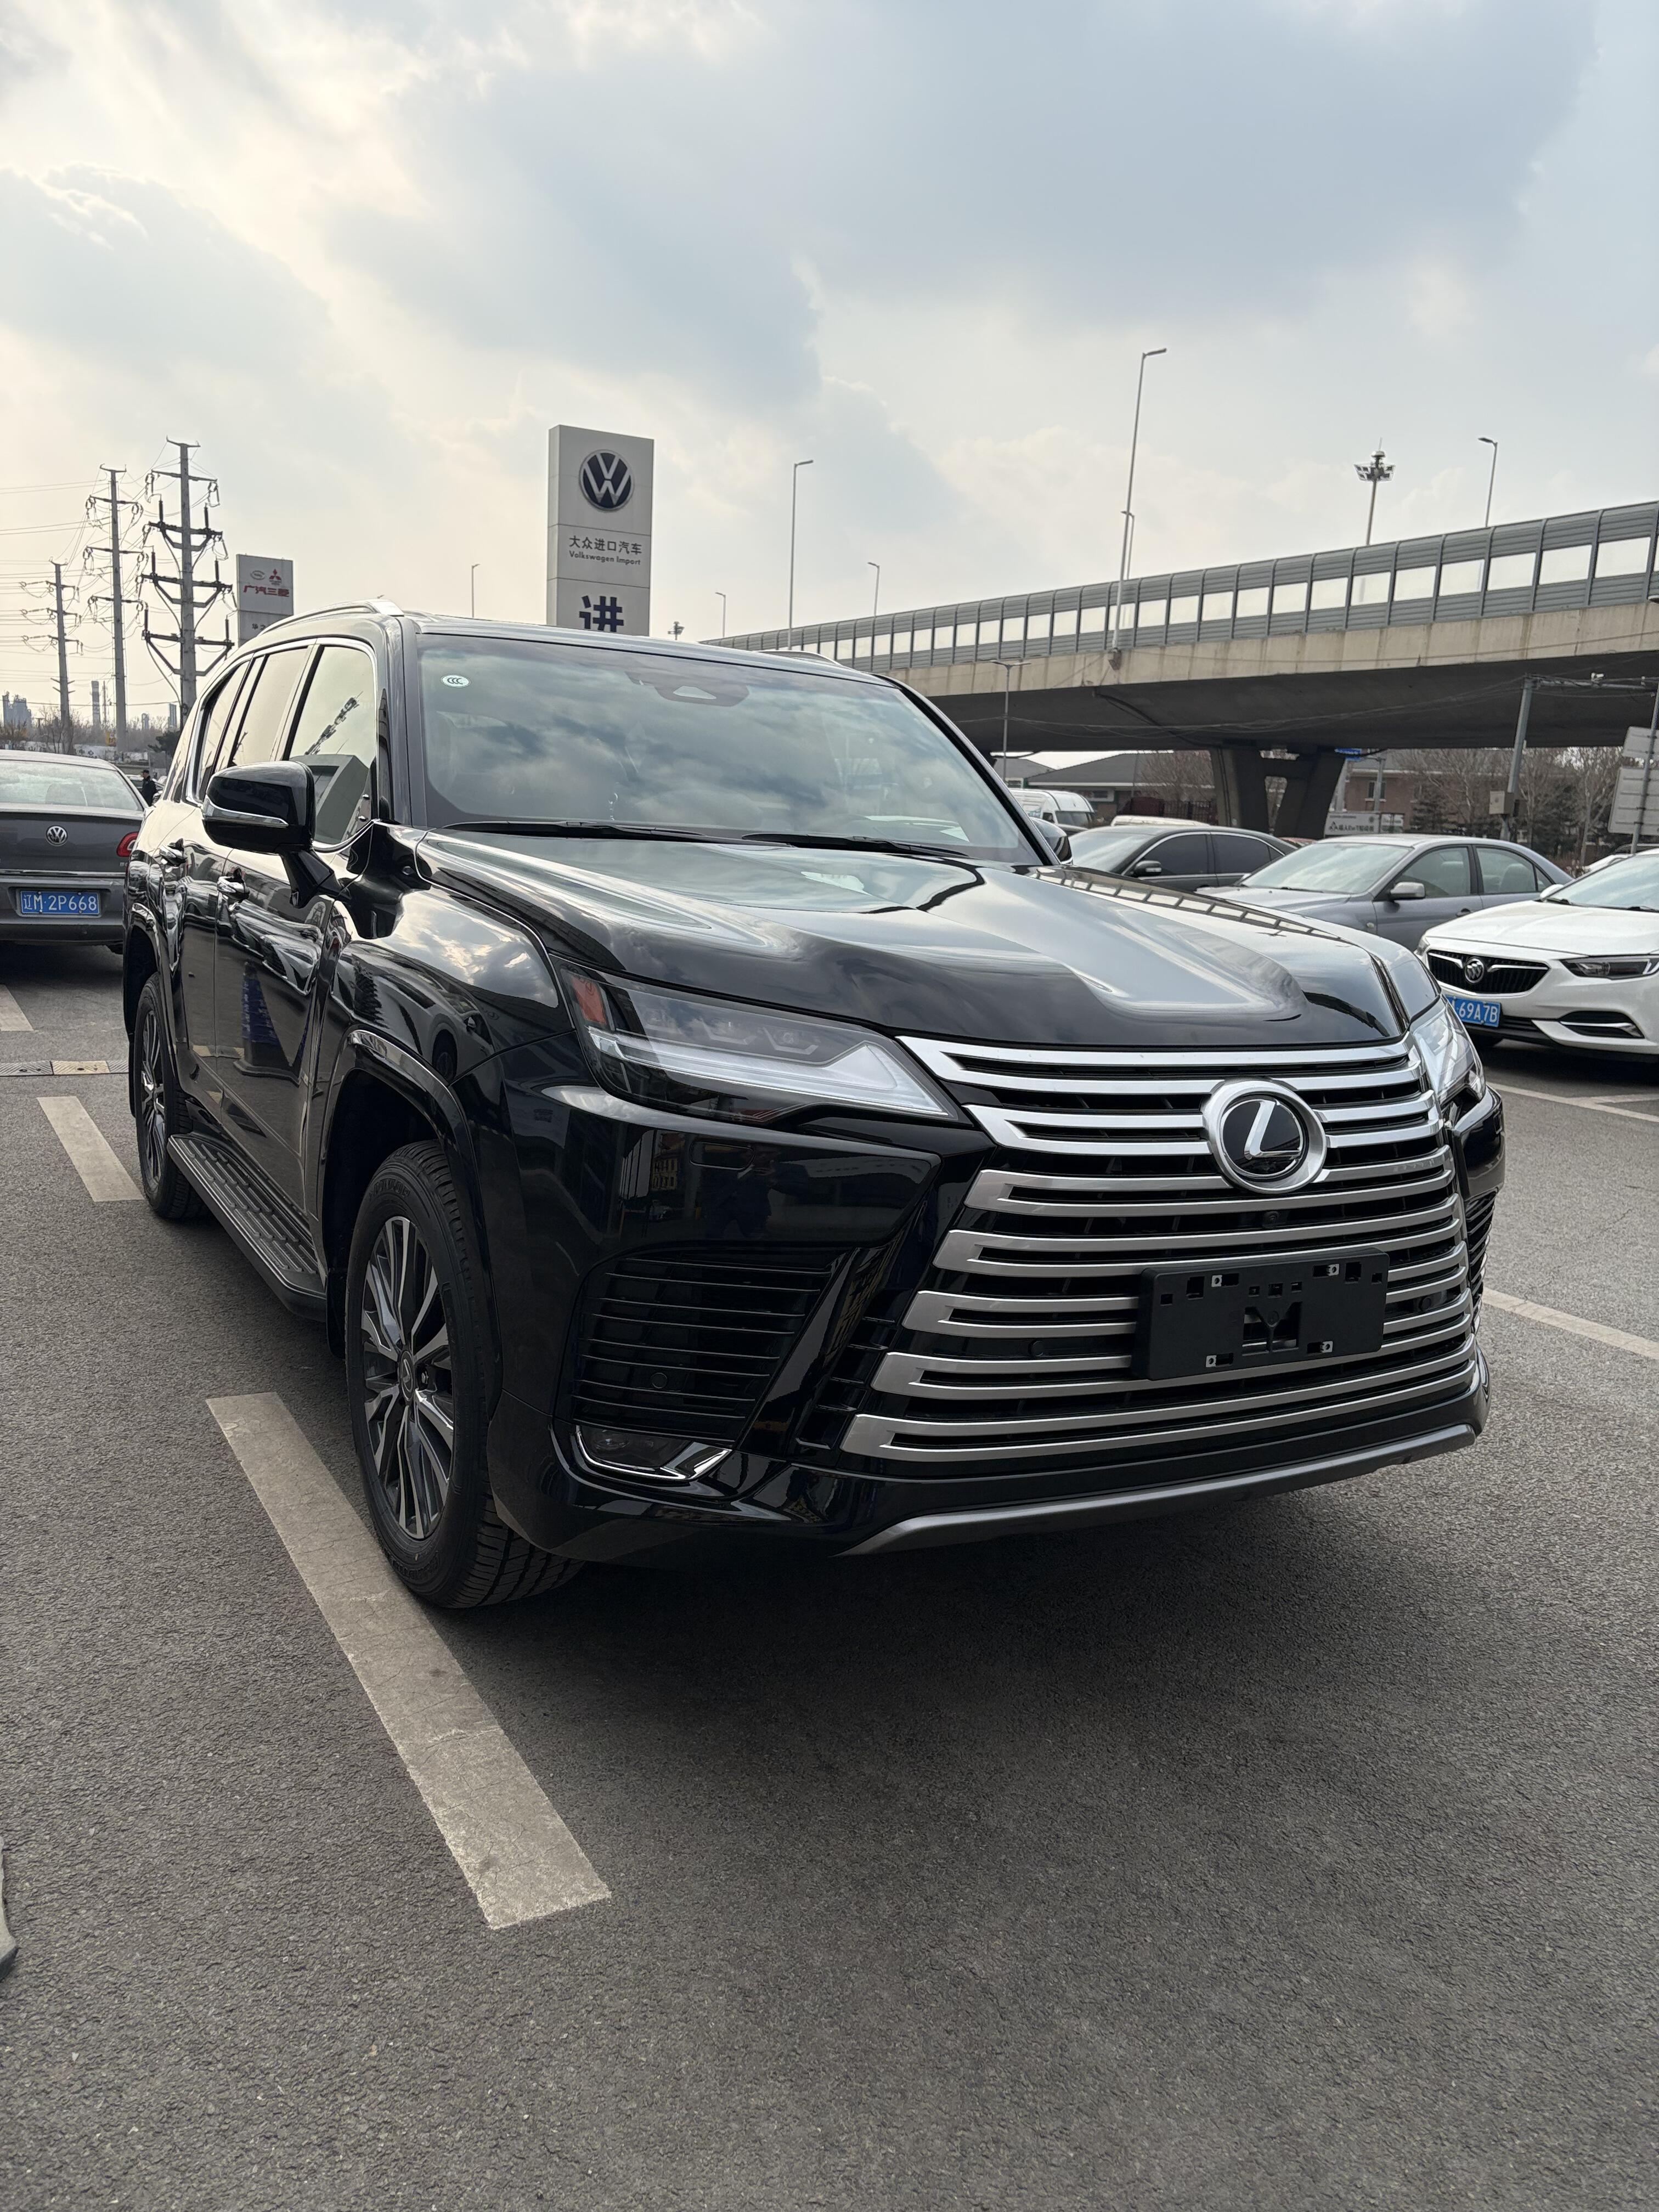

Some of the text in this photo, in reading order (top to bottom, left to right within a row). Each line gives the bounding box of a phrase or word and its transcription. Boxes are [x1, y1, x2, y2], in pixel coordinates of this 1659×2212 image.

[569, 535, 642, 555] 大众进口汽车
[569, 550, 641, 566] Volkswagen Import
